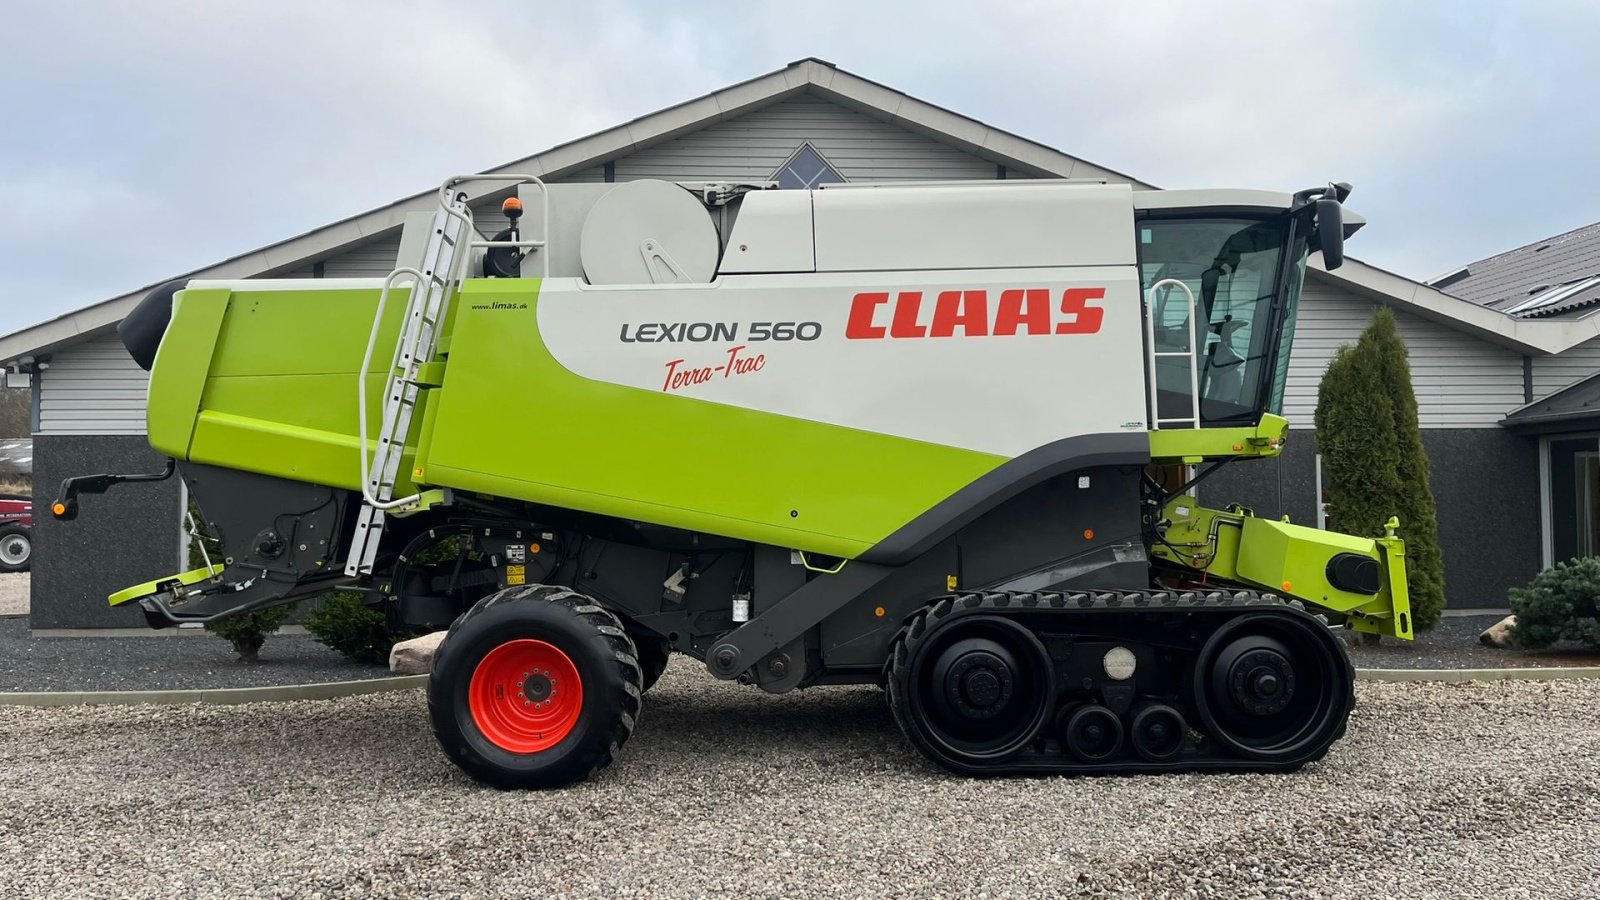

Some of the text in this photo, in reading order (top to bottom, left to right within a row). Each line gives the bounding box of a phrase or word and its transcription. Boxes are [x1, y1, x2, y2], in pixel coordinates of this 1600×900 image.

[471, 301, 528, 310] www.limas.dk
[845, 287, 1106, 340] CLAAS
[619, 321, 822, 343] LEXION 560
[662, 345, 766, 392] Terra-Trac
